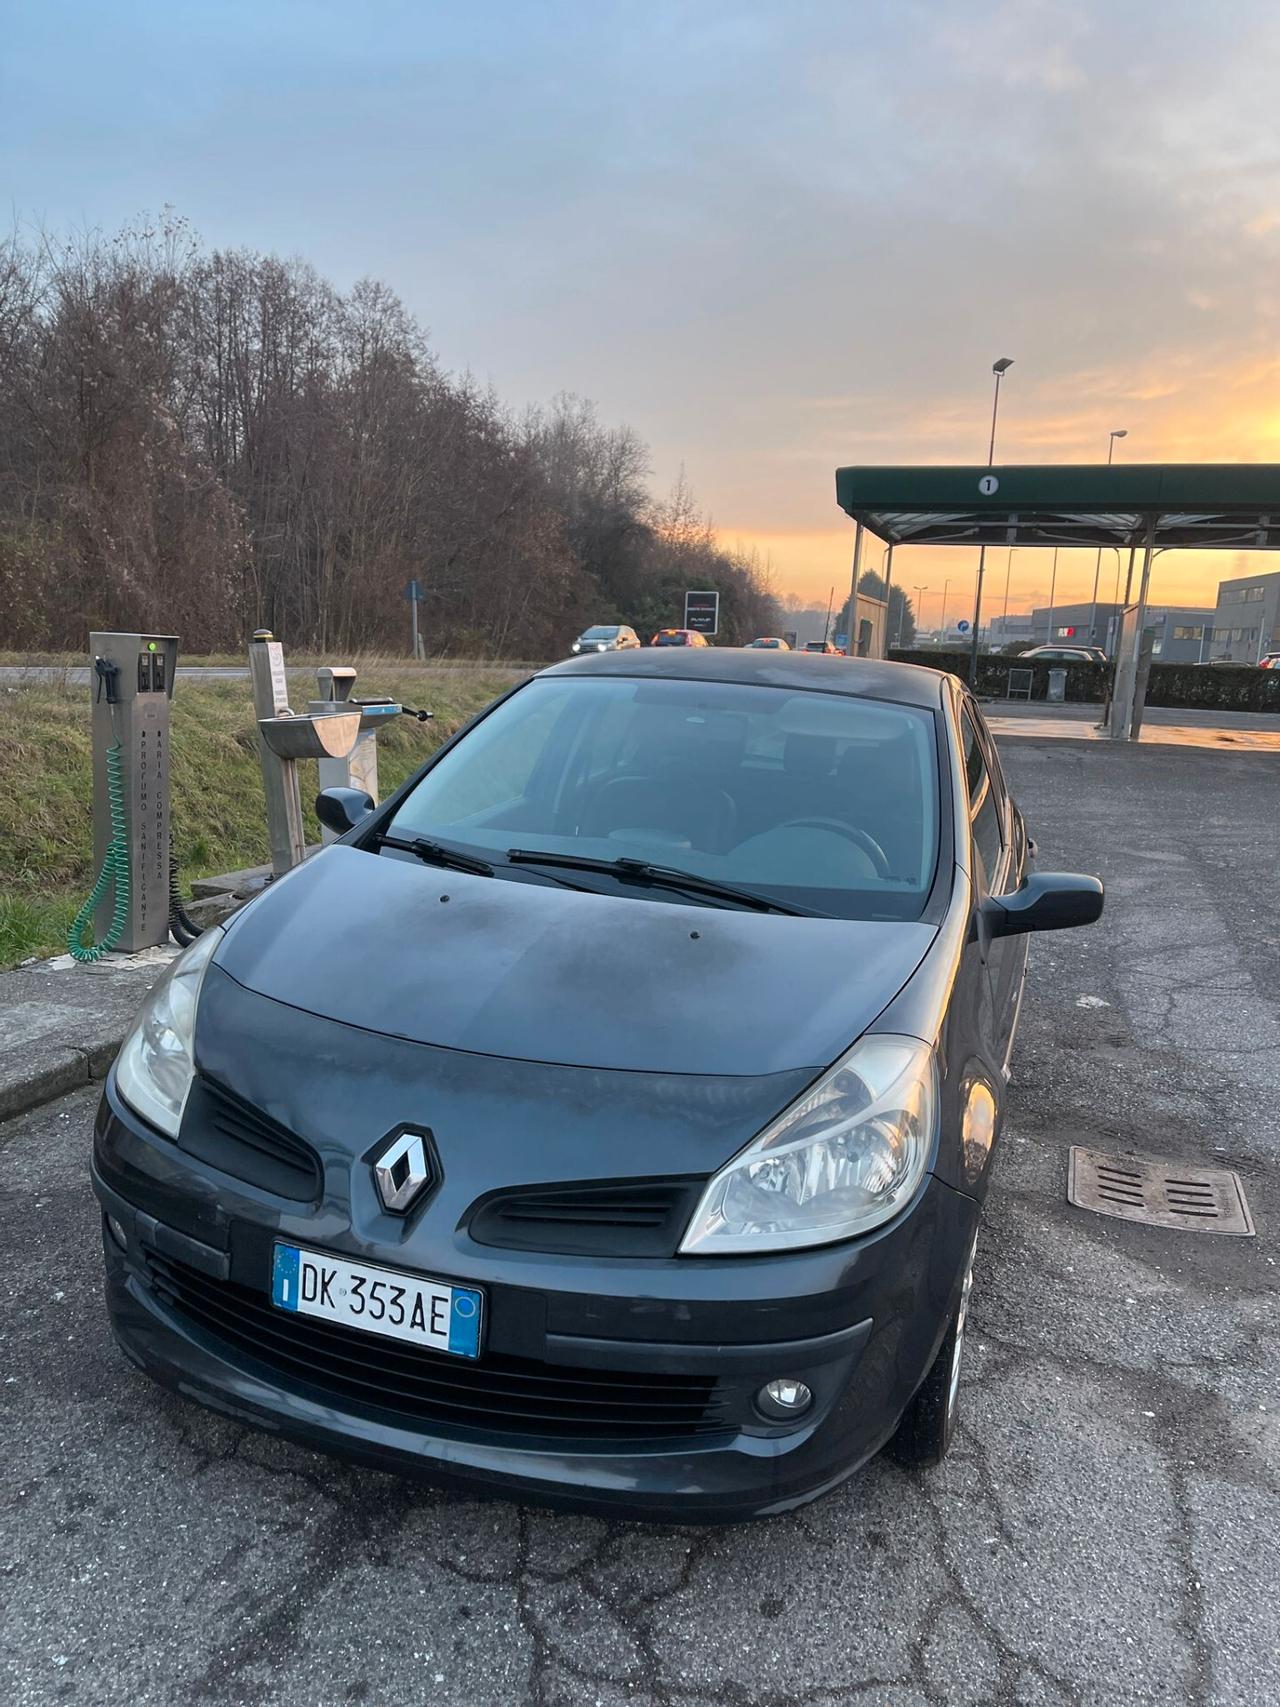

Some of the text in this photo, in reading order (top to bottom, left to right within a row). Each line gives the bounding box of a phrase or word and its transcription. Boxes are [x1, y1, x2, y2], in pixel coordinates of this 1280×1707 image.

[985, 479, 991, 492] 1
[301, 1263, 449, 1336] DK 353AE
